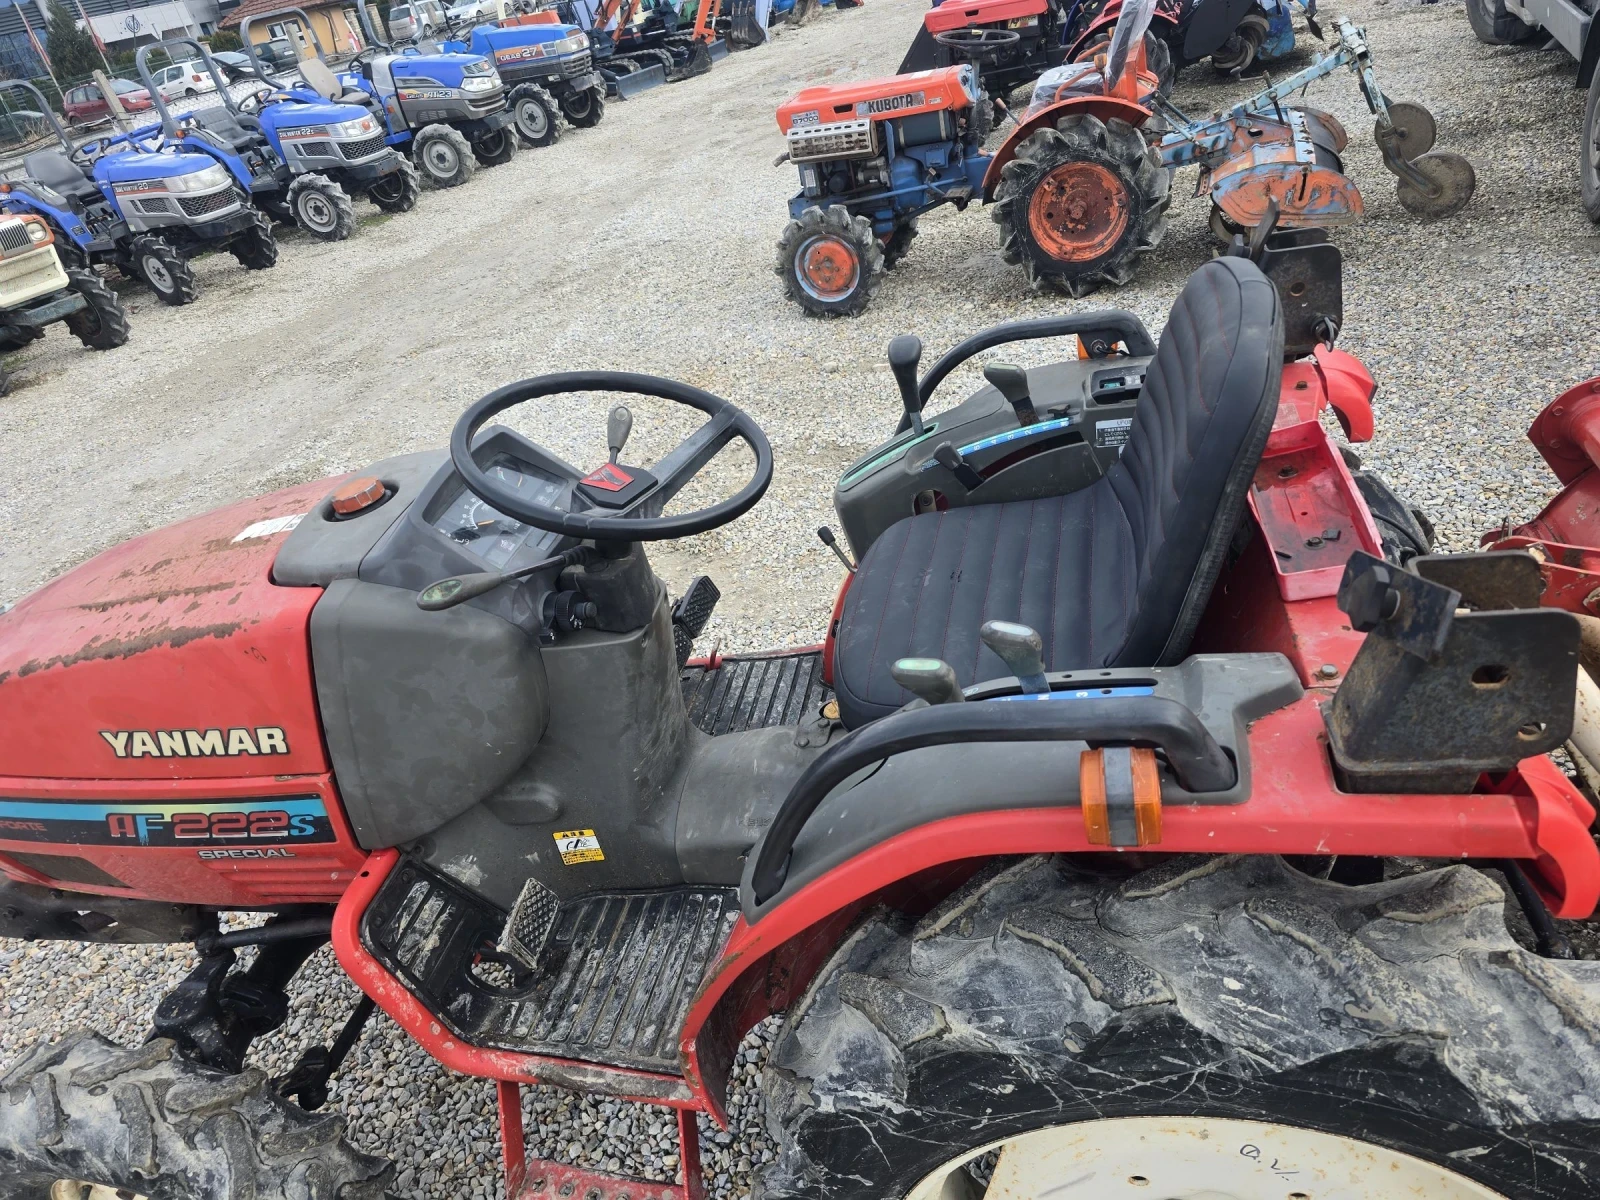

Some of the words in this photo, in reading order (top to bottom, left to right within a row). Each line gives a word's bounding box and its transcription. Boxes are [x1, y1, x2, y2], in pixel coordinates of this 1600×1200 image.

[521, 46, 538, 57] 27
[867, 93, 914, 114] KUBOTA
[138, 182, 149, 191] 20
[100, 727, 290, 758] YANMAR
[198, 848, 298, 860] SPECIAL
